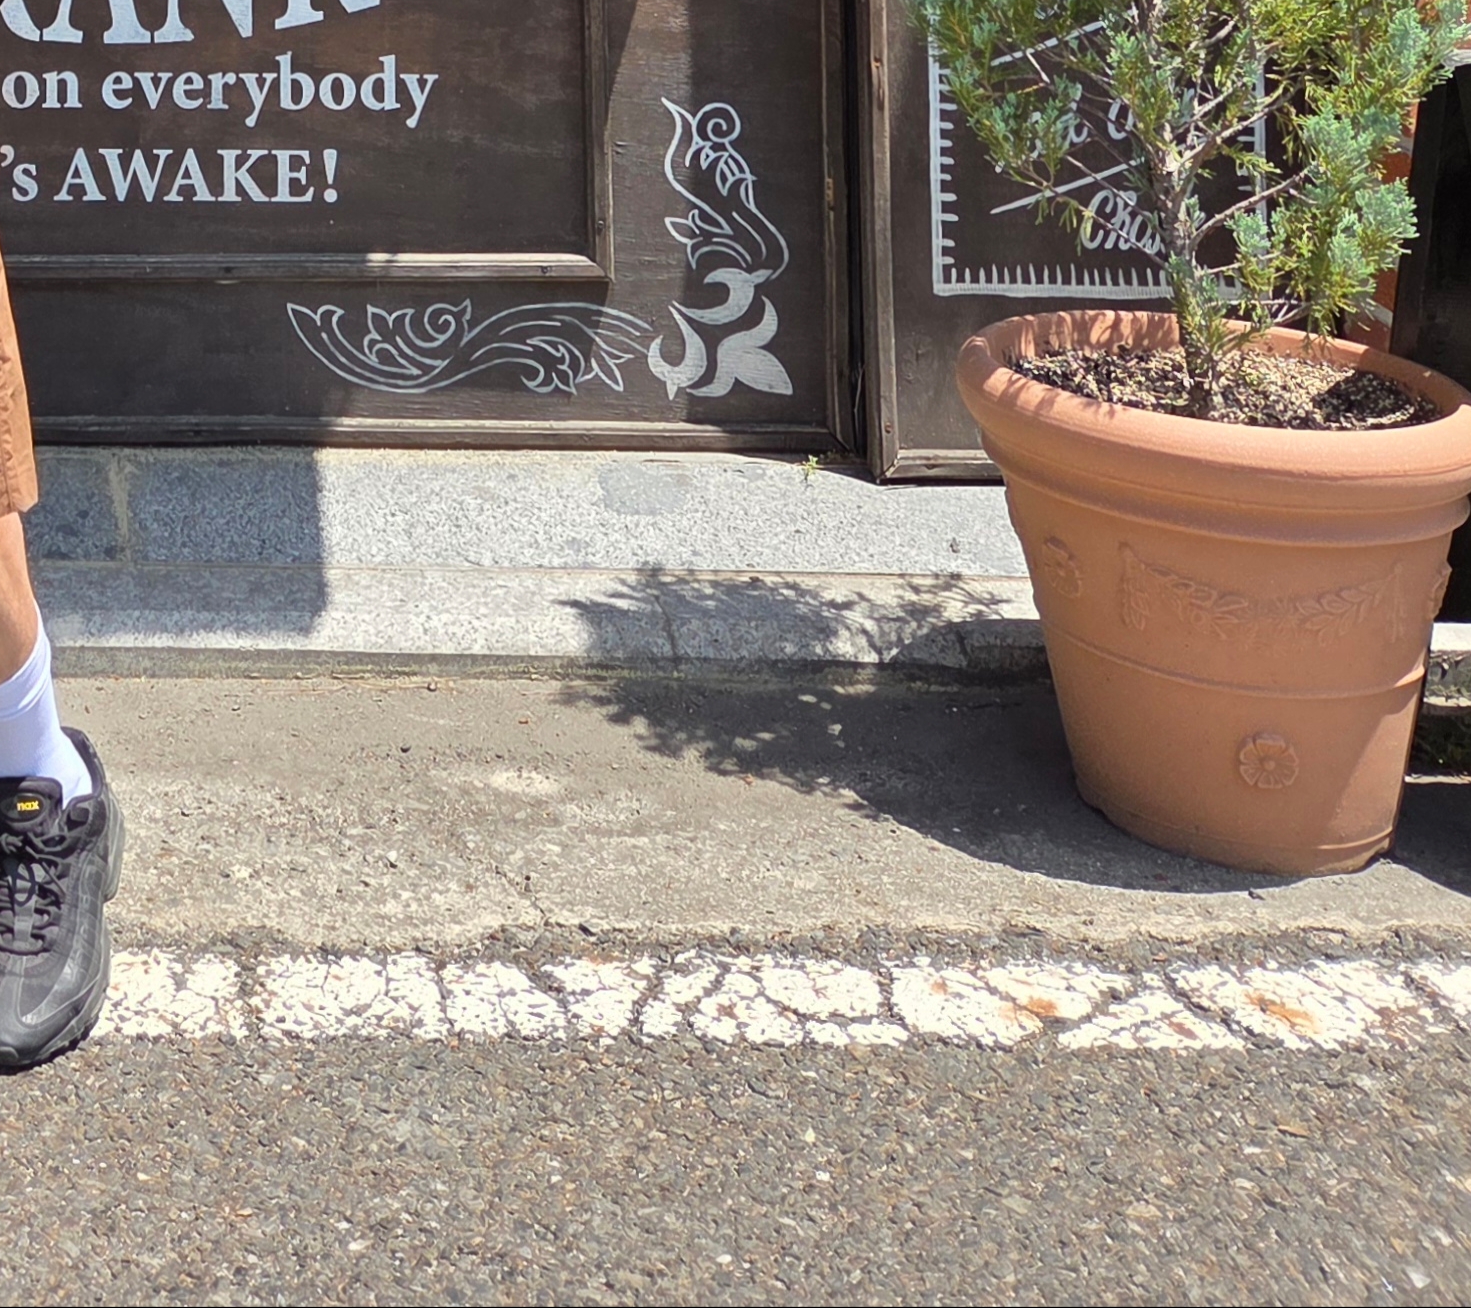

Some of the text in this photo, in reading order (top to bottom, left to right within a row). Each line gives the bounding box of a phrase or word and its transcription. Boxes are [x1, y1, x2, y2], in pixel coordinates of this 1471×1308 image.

[1, 51, 439, 129] on everybody
[53, 147, 338, 203] AWAKE!
